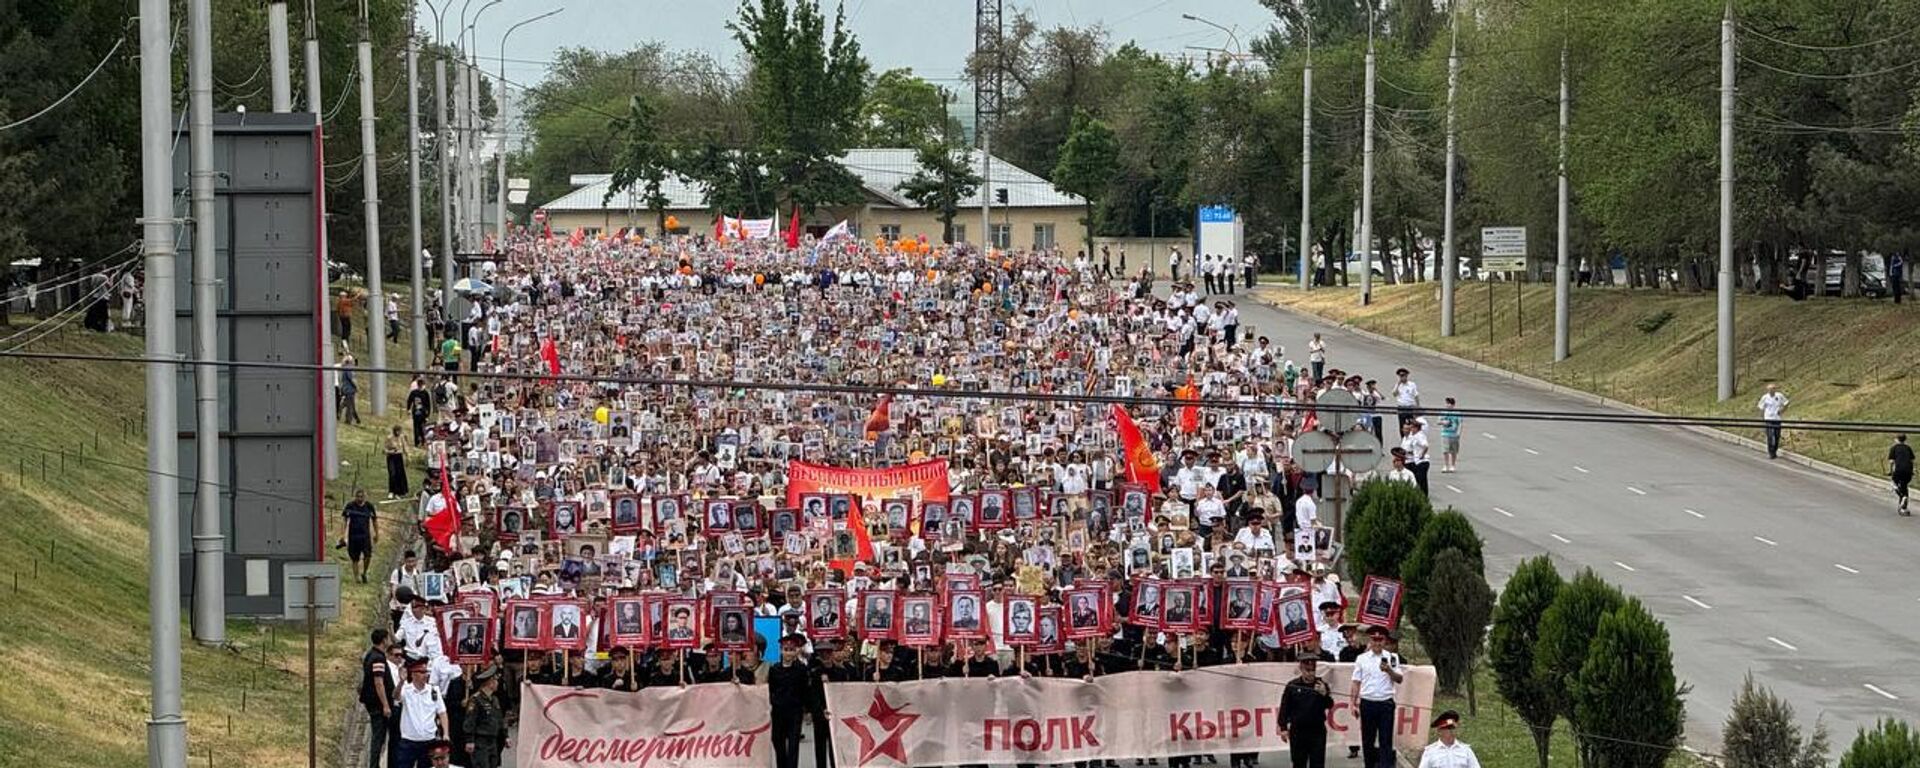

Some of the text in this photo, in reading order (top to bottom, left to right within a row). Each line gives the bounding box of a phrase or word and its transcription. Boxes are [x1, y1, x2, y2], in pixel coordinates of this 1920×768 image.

[909, 461, 946, 483] ПОЛК
[540, 692, 1420, 768] бессмертный ПОЛК КЫРГСН
